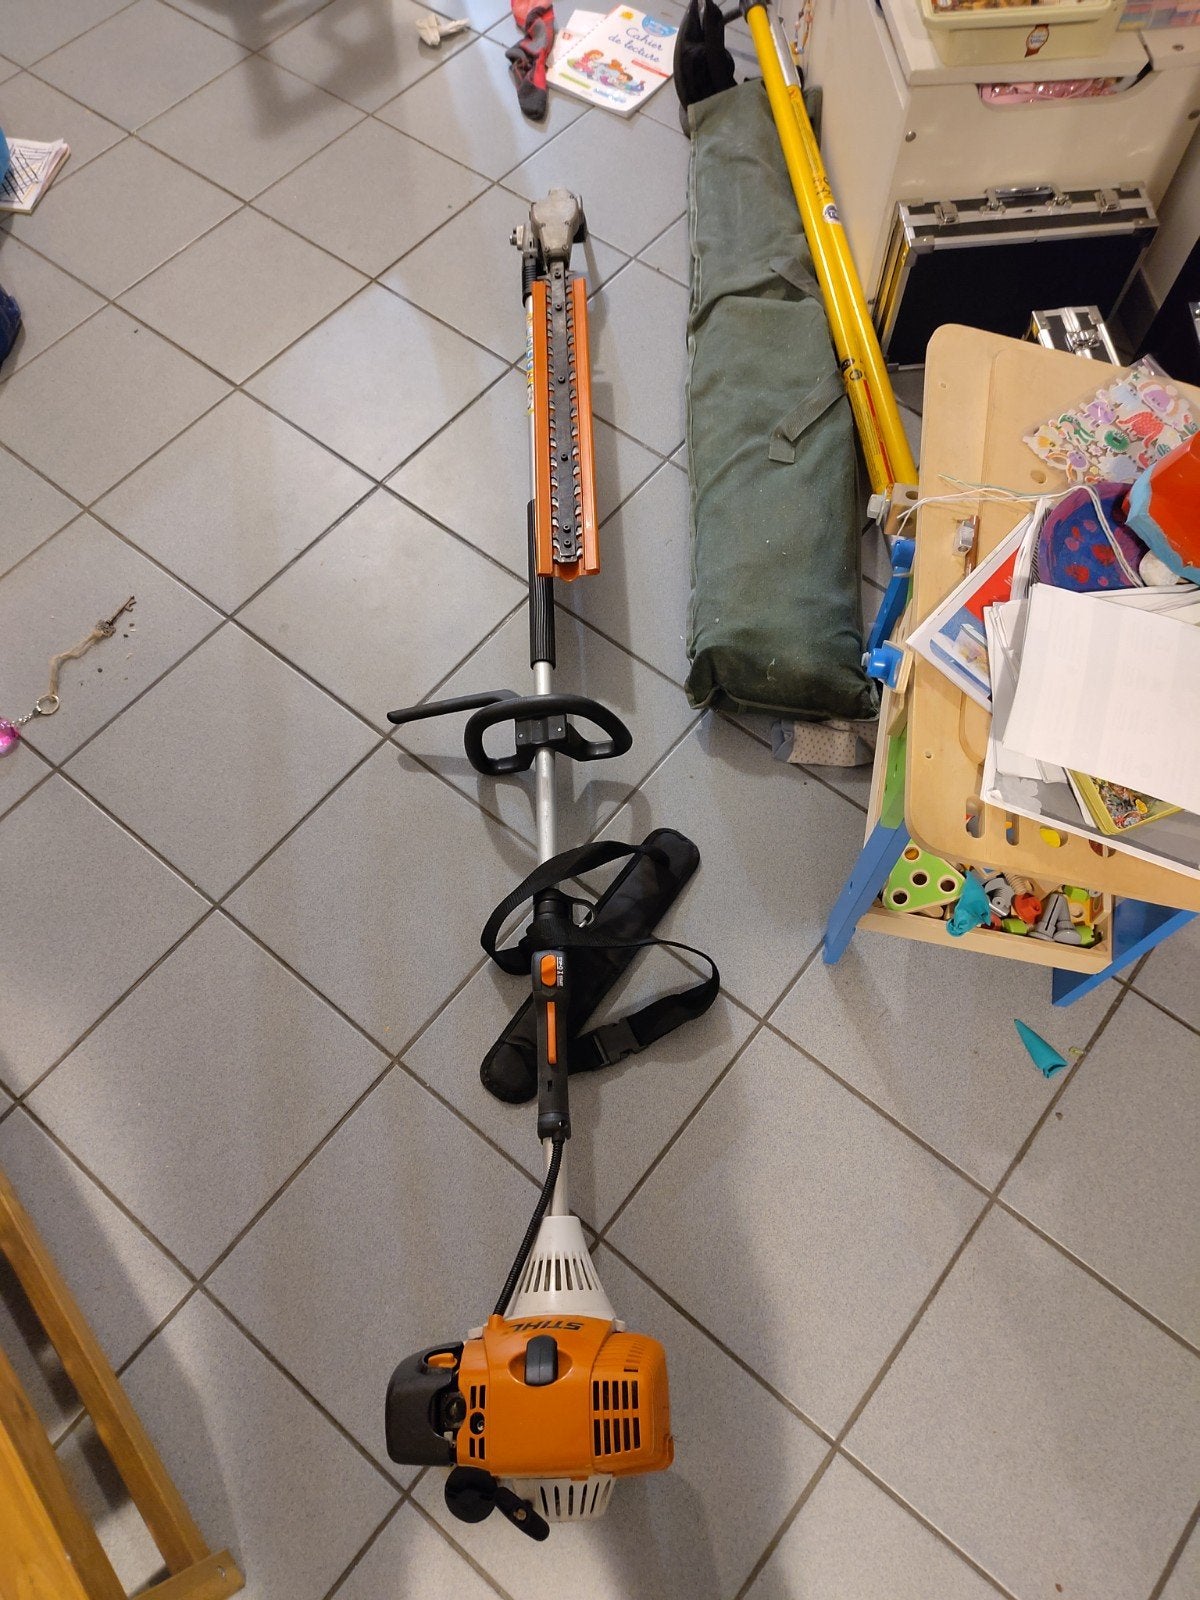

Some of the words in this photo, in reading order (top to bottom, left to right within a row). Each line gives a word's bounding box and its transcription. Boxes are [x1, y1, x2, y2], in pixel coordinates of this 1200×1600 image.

[608, 34, 621, 44] de
[624, 40, 660, 62] lecture
[626, 27, 663, 51] Cahier
[509, 1320, 584, 1332] STIHL
